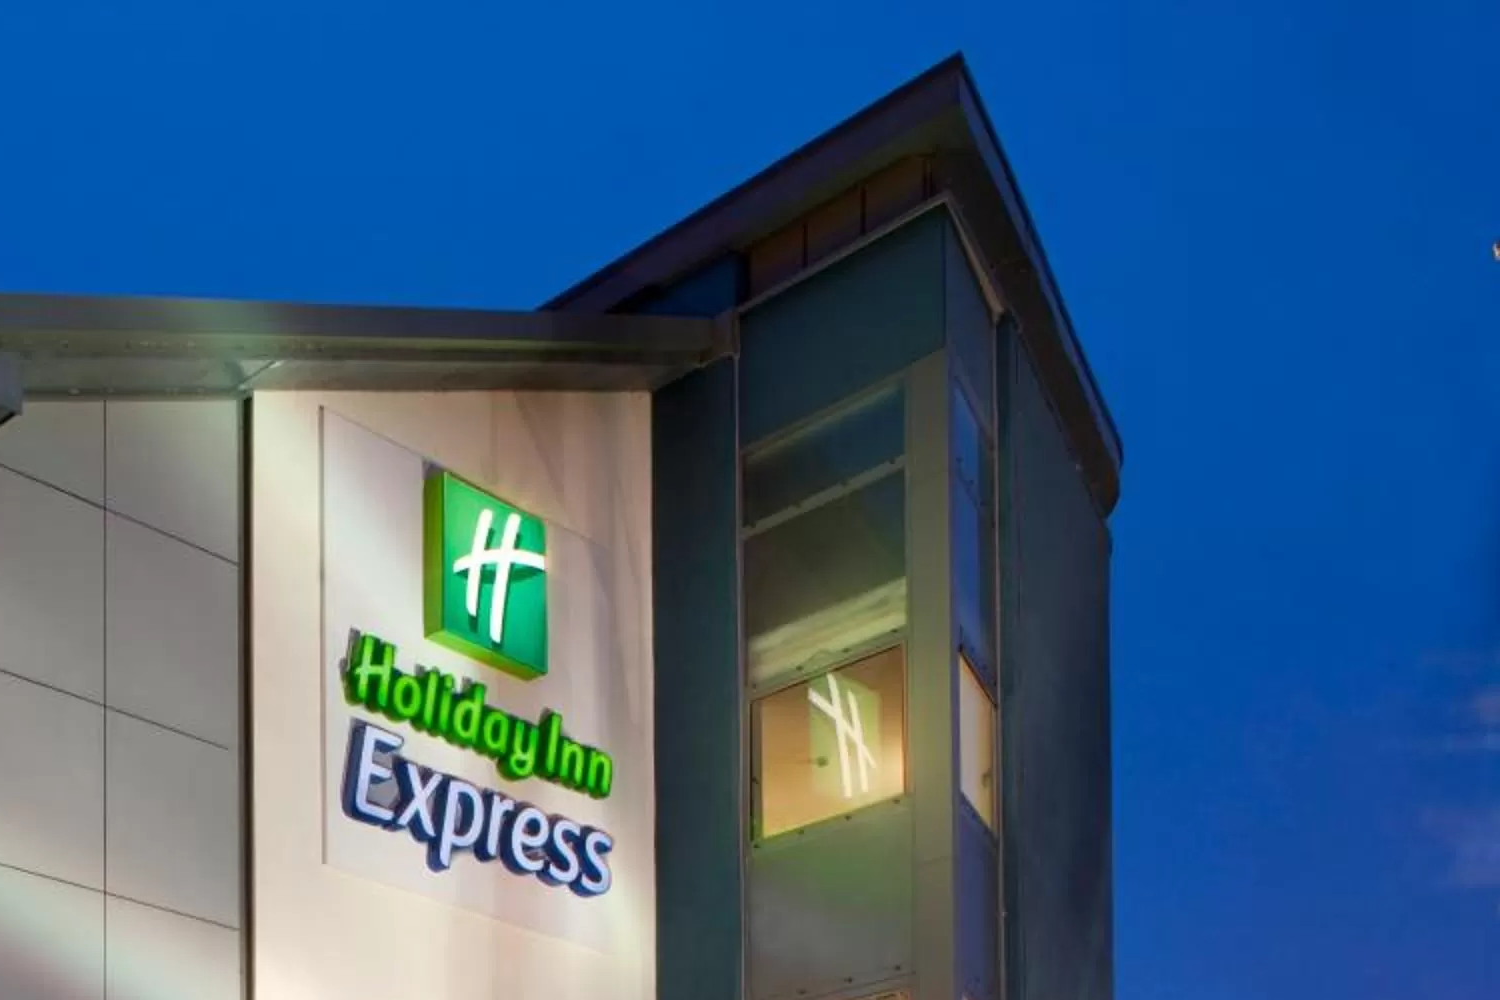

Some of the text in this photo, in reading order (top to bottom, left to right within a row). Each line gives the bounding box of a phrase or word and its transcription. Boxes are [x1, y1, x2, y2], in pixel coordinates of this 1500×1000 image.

[453, 509, 546, 644] H
[345, 631, 613, 799] Holiday Inn
[344, 719, 613, 896] Express
